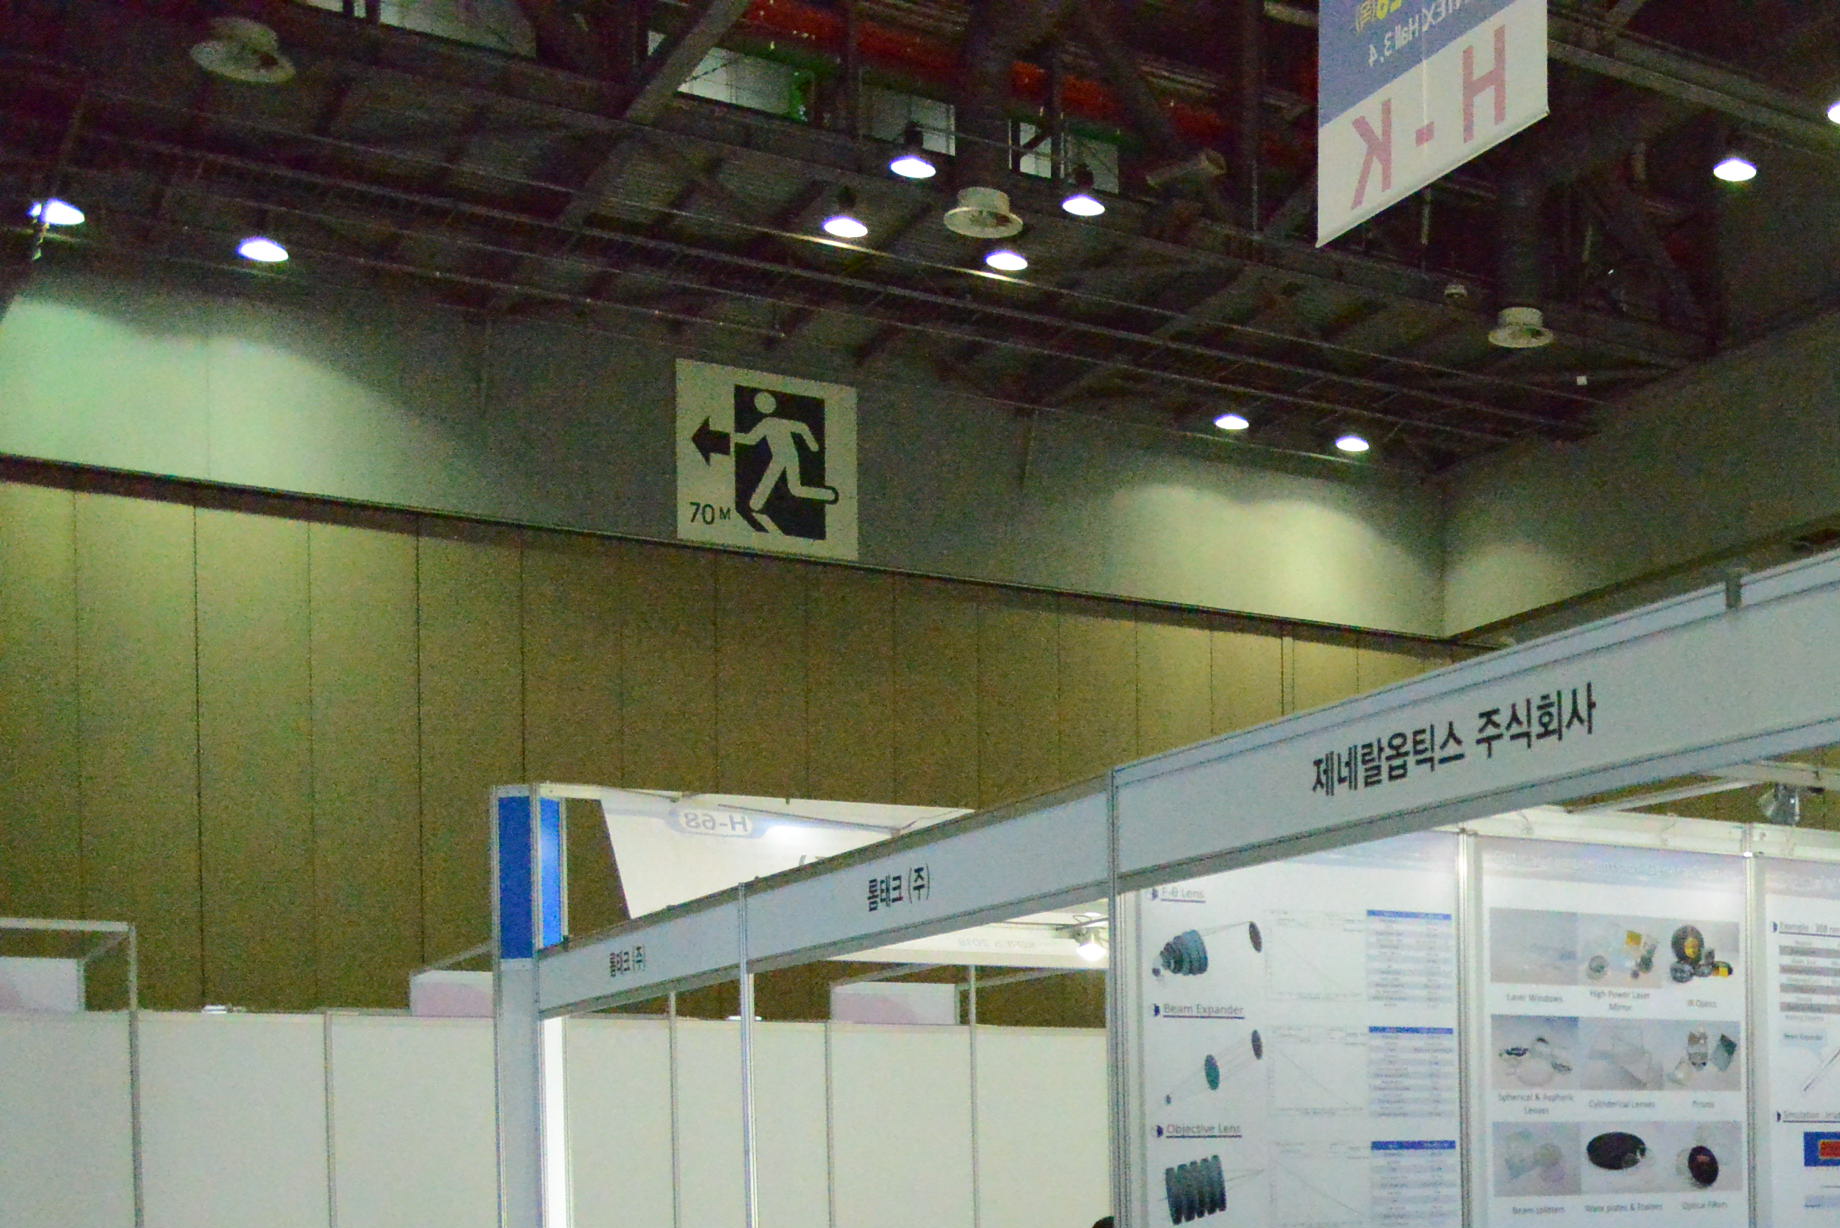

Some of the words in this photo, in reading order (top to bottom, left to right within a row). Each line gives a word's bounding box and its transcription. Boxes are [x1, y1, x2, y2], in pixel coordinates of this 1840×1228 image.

[1312, 721, 1466, 796] 제네랄옵틱스
[1475, 682, 1597, 759] 주식회사
[1163, 1003, 1194, 1014] Beam
[1196, 1003, 1245, 1017] Expander
[1166, 1122, 1216, 1136] Objective
[1218, 1122, 1241, 1134] Lens
